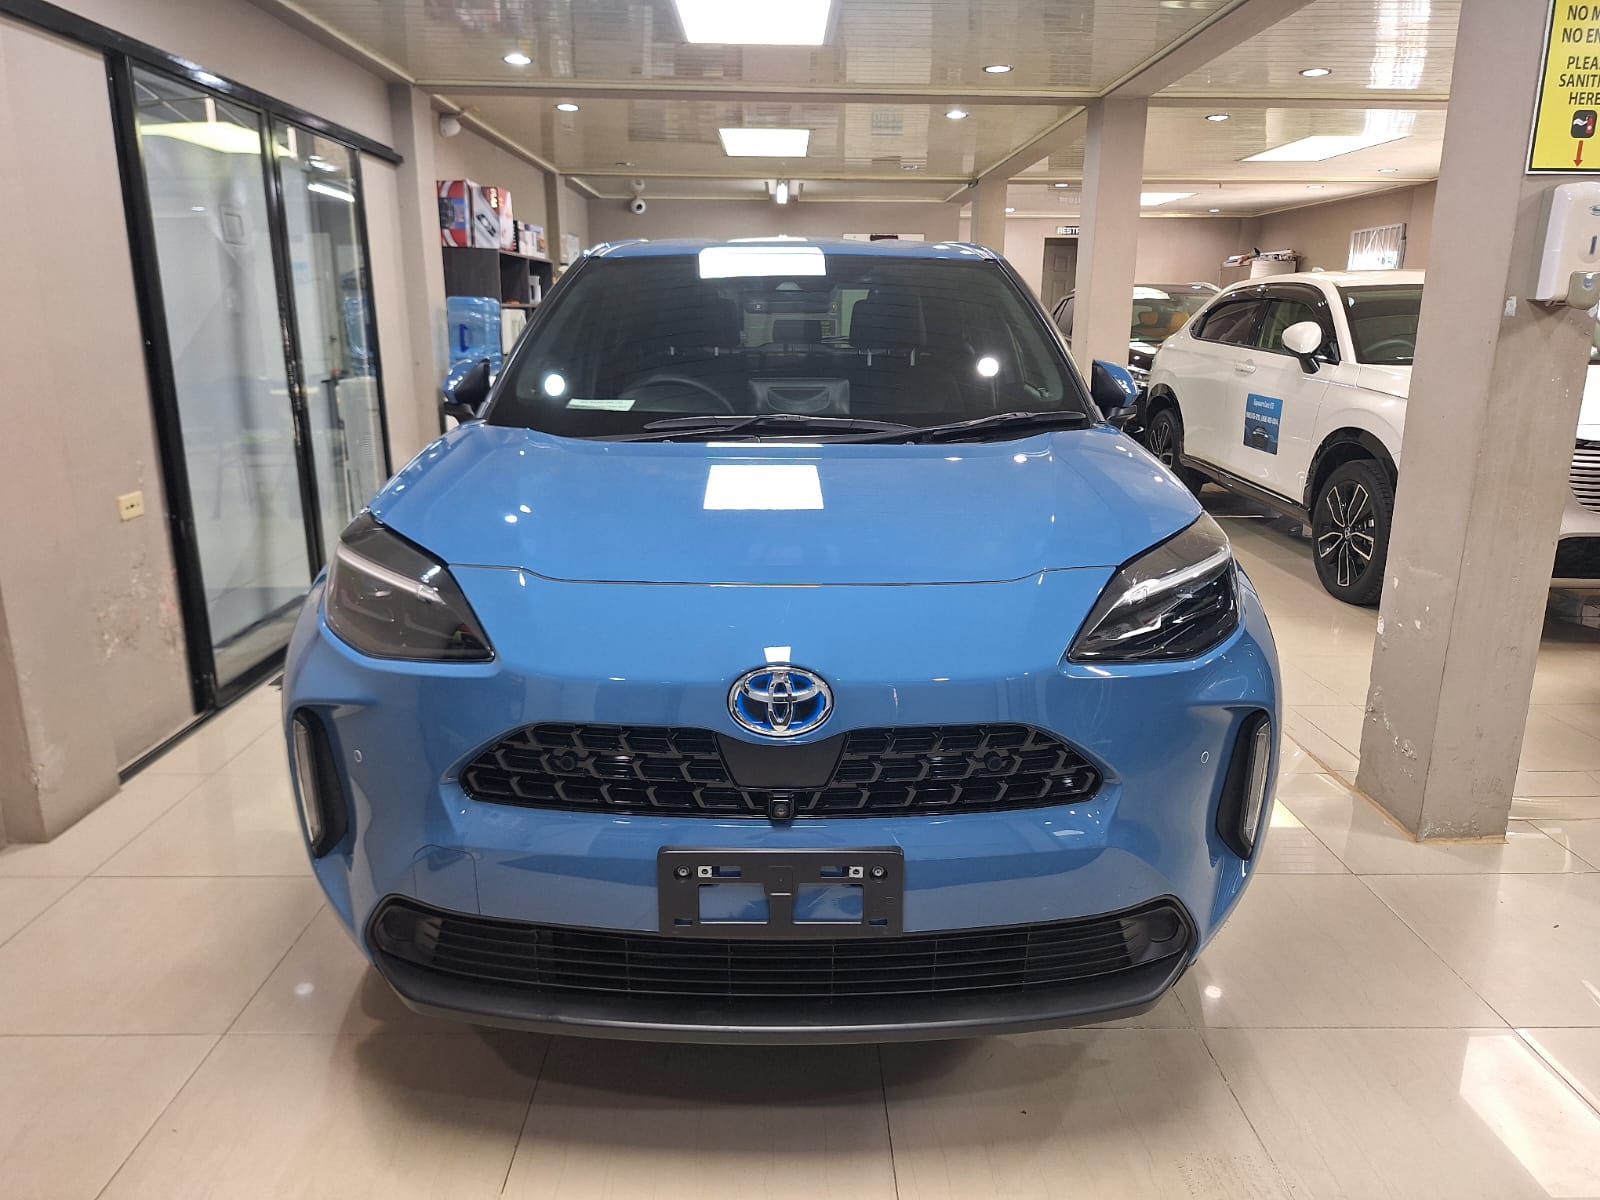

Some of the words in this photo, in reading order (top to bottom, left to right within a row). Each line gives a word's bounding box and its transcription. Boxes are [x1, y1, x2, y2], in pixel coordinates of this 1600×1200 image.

[1567, 5, 1588, 21] NO
[1562, 28, 1583, 43] NO
[1567, 56, 1600, 70] PLEA
[1569, 92, 1600, 105] HERE
